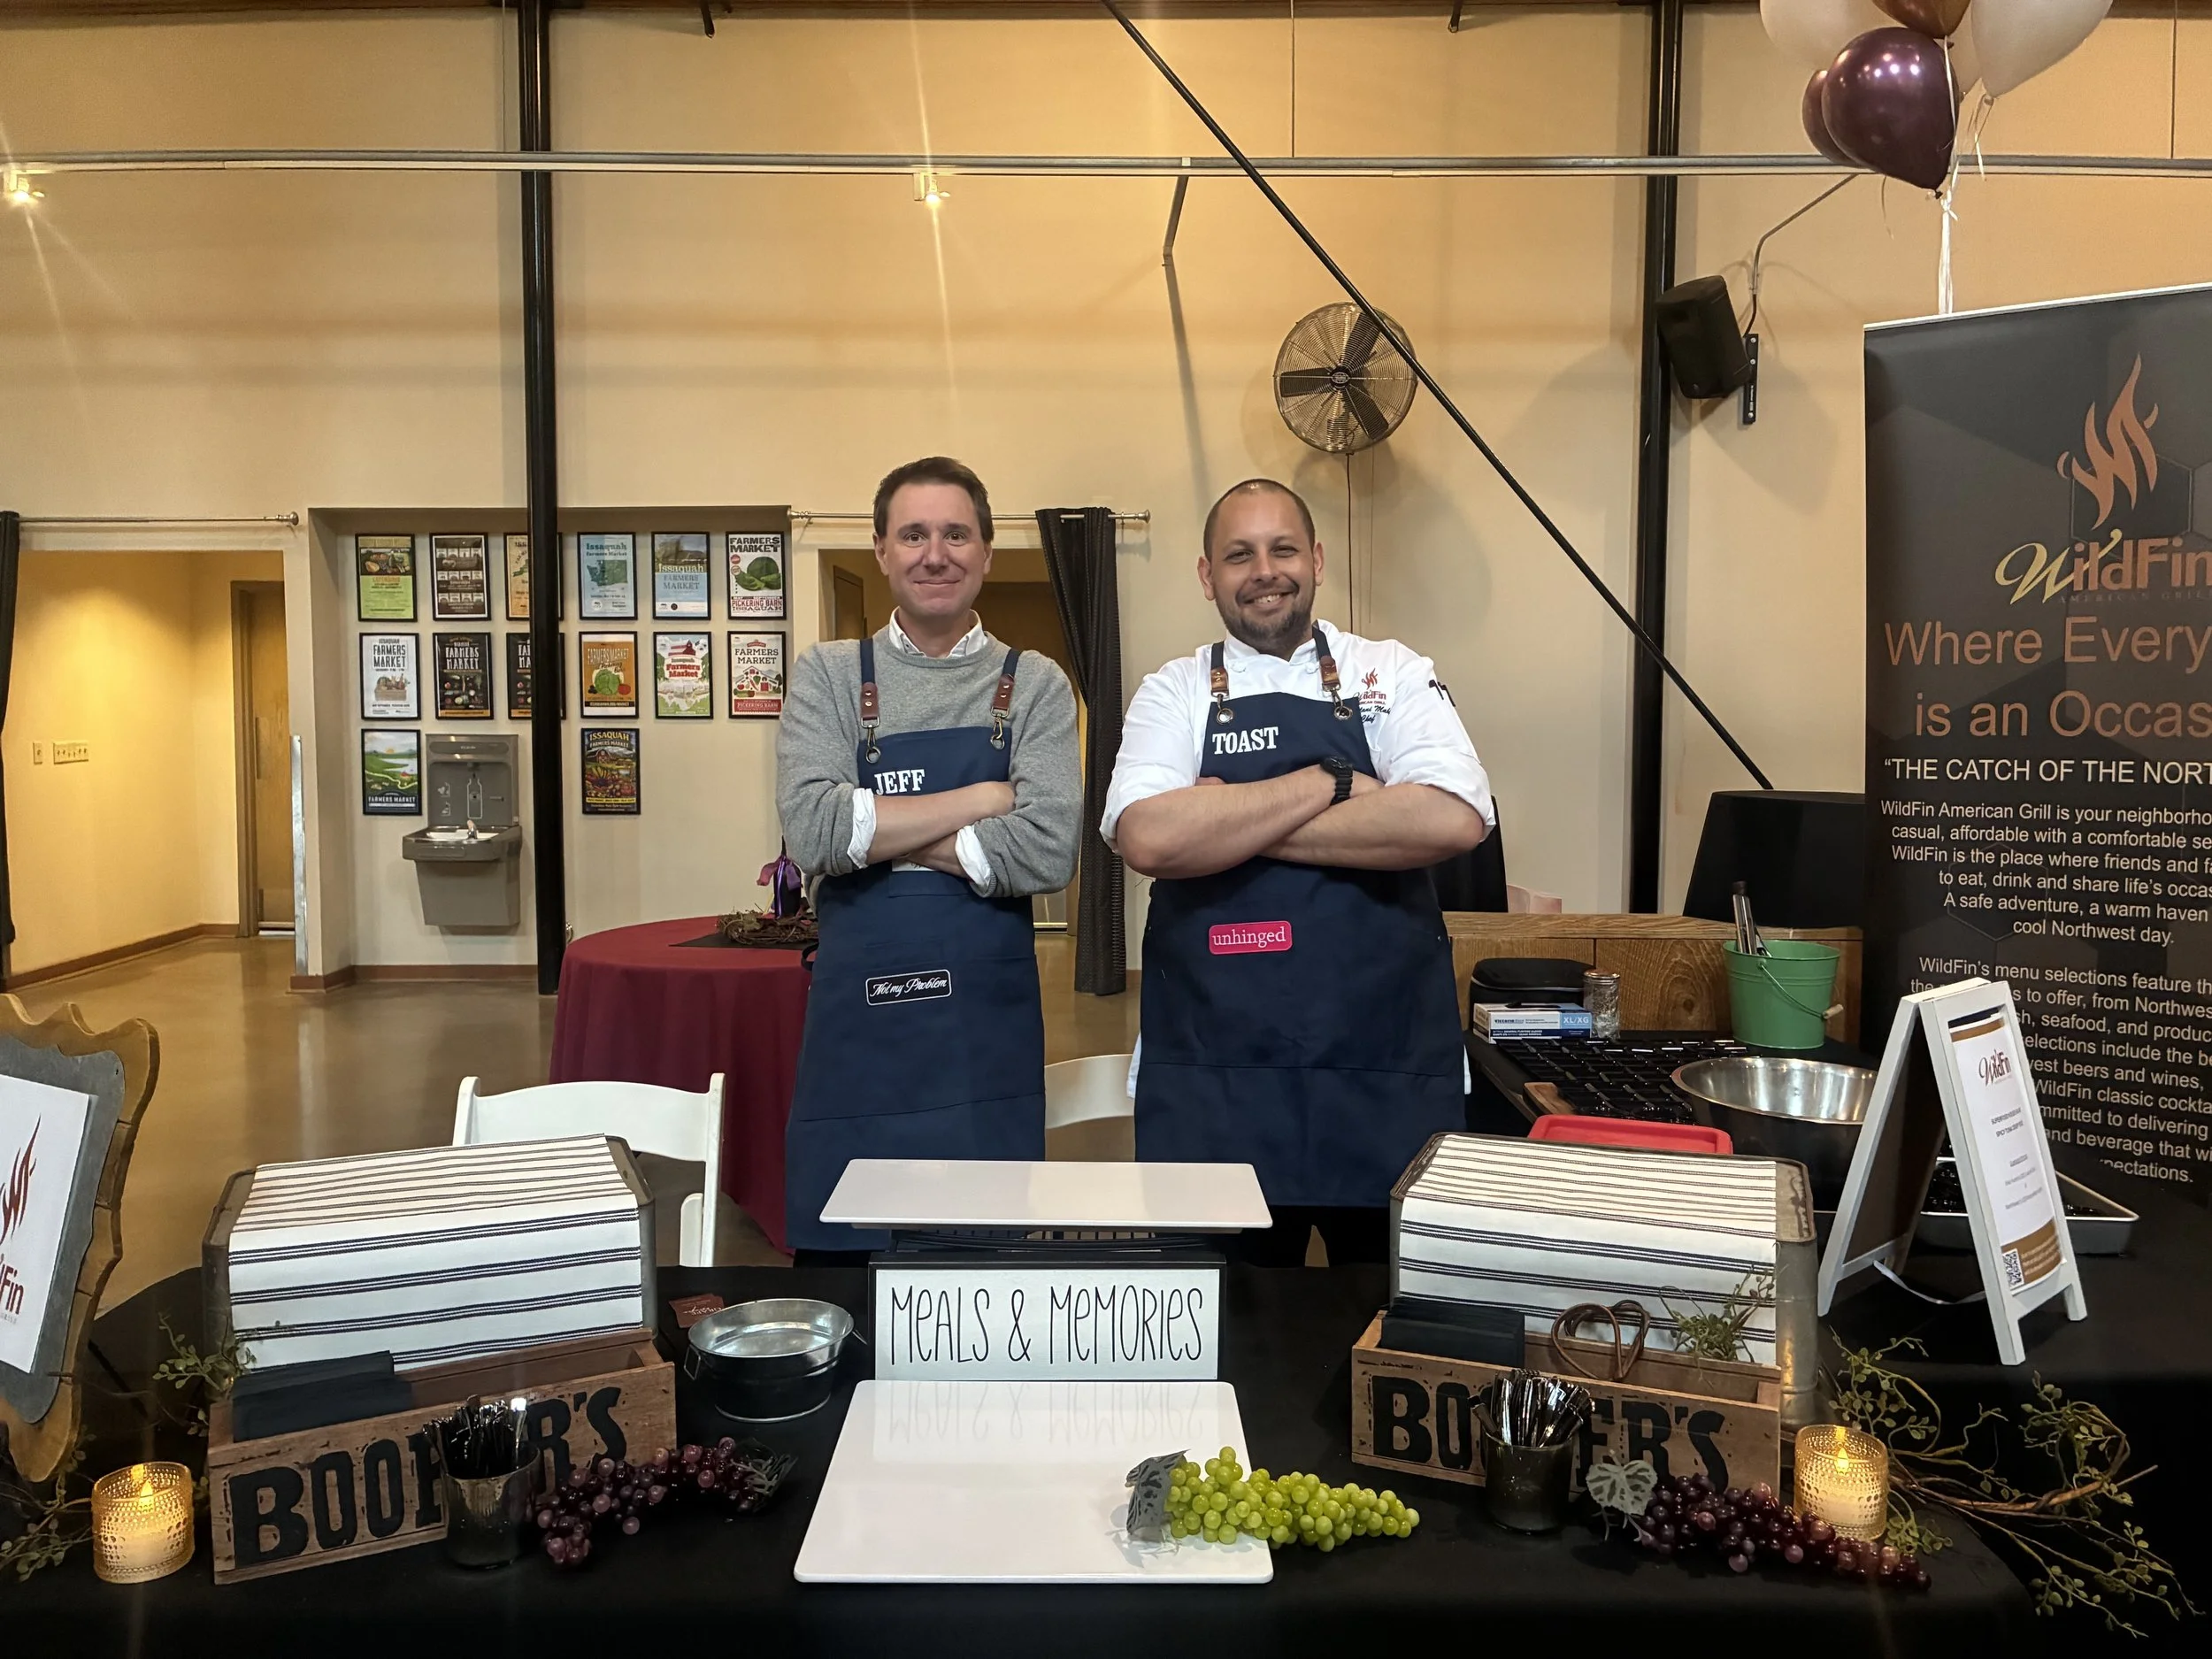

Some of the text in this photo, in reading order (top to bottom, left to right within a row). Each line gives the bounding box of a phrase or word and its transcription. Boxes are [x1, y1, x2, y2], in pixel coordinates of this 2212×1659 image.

[658, 564, 703, 573] Issaquah
[1995, 529, 2212, 604] WildFin
[373, 645, 406, 656] FARMERS
[446, 648, 479, 658] FARMERS
[1885, 616, 2212, 673] Where Every
[373, 657, 406, 668] MARKET
[447, 658, 479, 670] MARKET
[1916, 690, 2212, 737] is an Occas
[590, 731, 629, 740] ISSAQUAH
[1212, 726, 1279, 755] TOAST
[874, 769, 925, 795] JEFF
[1885, 758, 1938, 780] "THE
[1946, 758, 2030, 781] CATCH
[2039, 759, 2074, 782] OF
[2082, 760, 2134, 783] THE
[1881, 800, 2212, 826] WildFin American Grill is your neighborho
[1892, 825, 2212, 850] casual, affordable with a comfortable se
[1892, 845, 1947, 862] WildFin
[1953, 848, 1966, 863] is
[1970, 848, 1995, 864] the
[2001, 849, 2043, 868] place
[2048, 851, 2099, 868] where
[2105, 853, 2161, 871] friends
[2166, 858, 2199, 873] and
[1939, 870, 1953, 884] to
[1959, 872, 1987, 888] eat,
[1993, 872, 2032, 888] drink
[2037, 874, 2067, 890] and
[2073, 876, 2120, 893] share
[2124, 877, 2162, 895] life's
[1944, 892, 2208, 922] A safe adventure, a warm haven
[1212, 926, 1286, 949] unhinged
[2013, 920, 2175, 948] cool Northwest day.
[870, 977, 947, 997] Not my Problem
[1919, 957, 1990, 976] WildFin's
[1995, 964, 2039, 980] menu
[2045, 967, 2127, 987] selections
[2132, 972, 2191, 993] feature
[2027, 988, 2041, 1002] to
[2047, 990, 2086, 1009] offer,
[2093, 993, 2129, 1010] from
[2135, 997, 2212, 1019] Northwes
[2041, 1013, 2112, 1034] seafood,
[2116, 1020, 2148, 1036] and
[2153, 1025, 2212, 1043] produc
[2024, 1033, 2097, 1055] elections
[2102, 1040, 2161, 1061] include
[2166, 1048, 2193, 1065] the
[1979, 1049, 2011, 1087] WildFin
[2063, 1059, 2109, 1079] beers
[2115, 1068, 2145, 1083] and
[2150, 1072, 2204, 1092] wines,
[2097, 1087, 2154, 1107] classic
[2158, 1095, 2212, 1115] cockta
[2108, 1111, 2123, 1127] to
[2128, 1114, 2208, 1141] delivering
[2076, 1131, 2154, 1156] beverage
[2159, 1141, 2191, 1160] that
[1008, 1289, 1031, 1362] &
